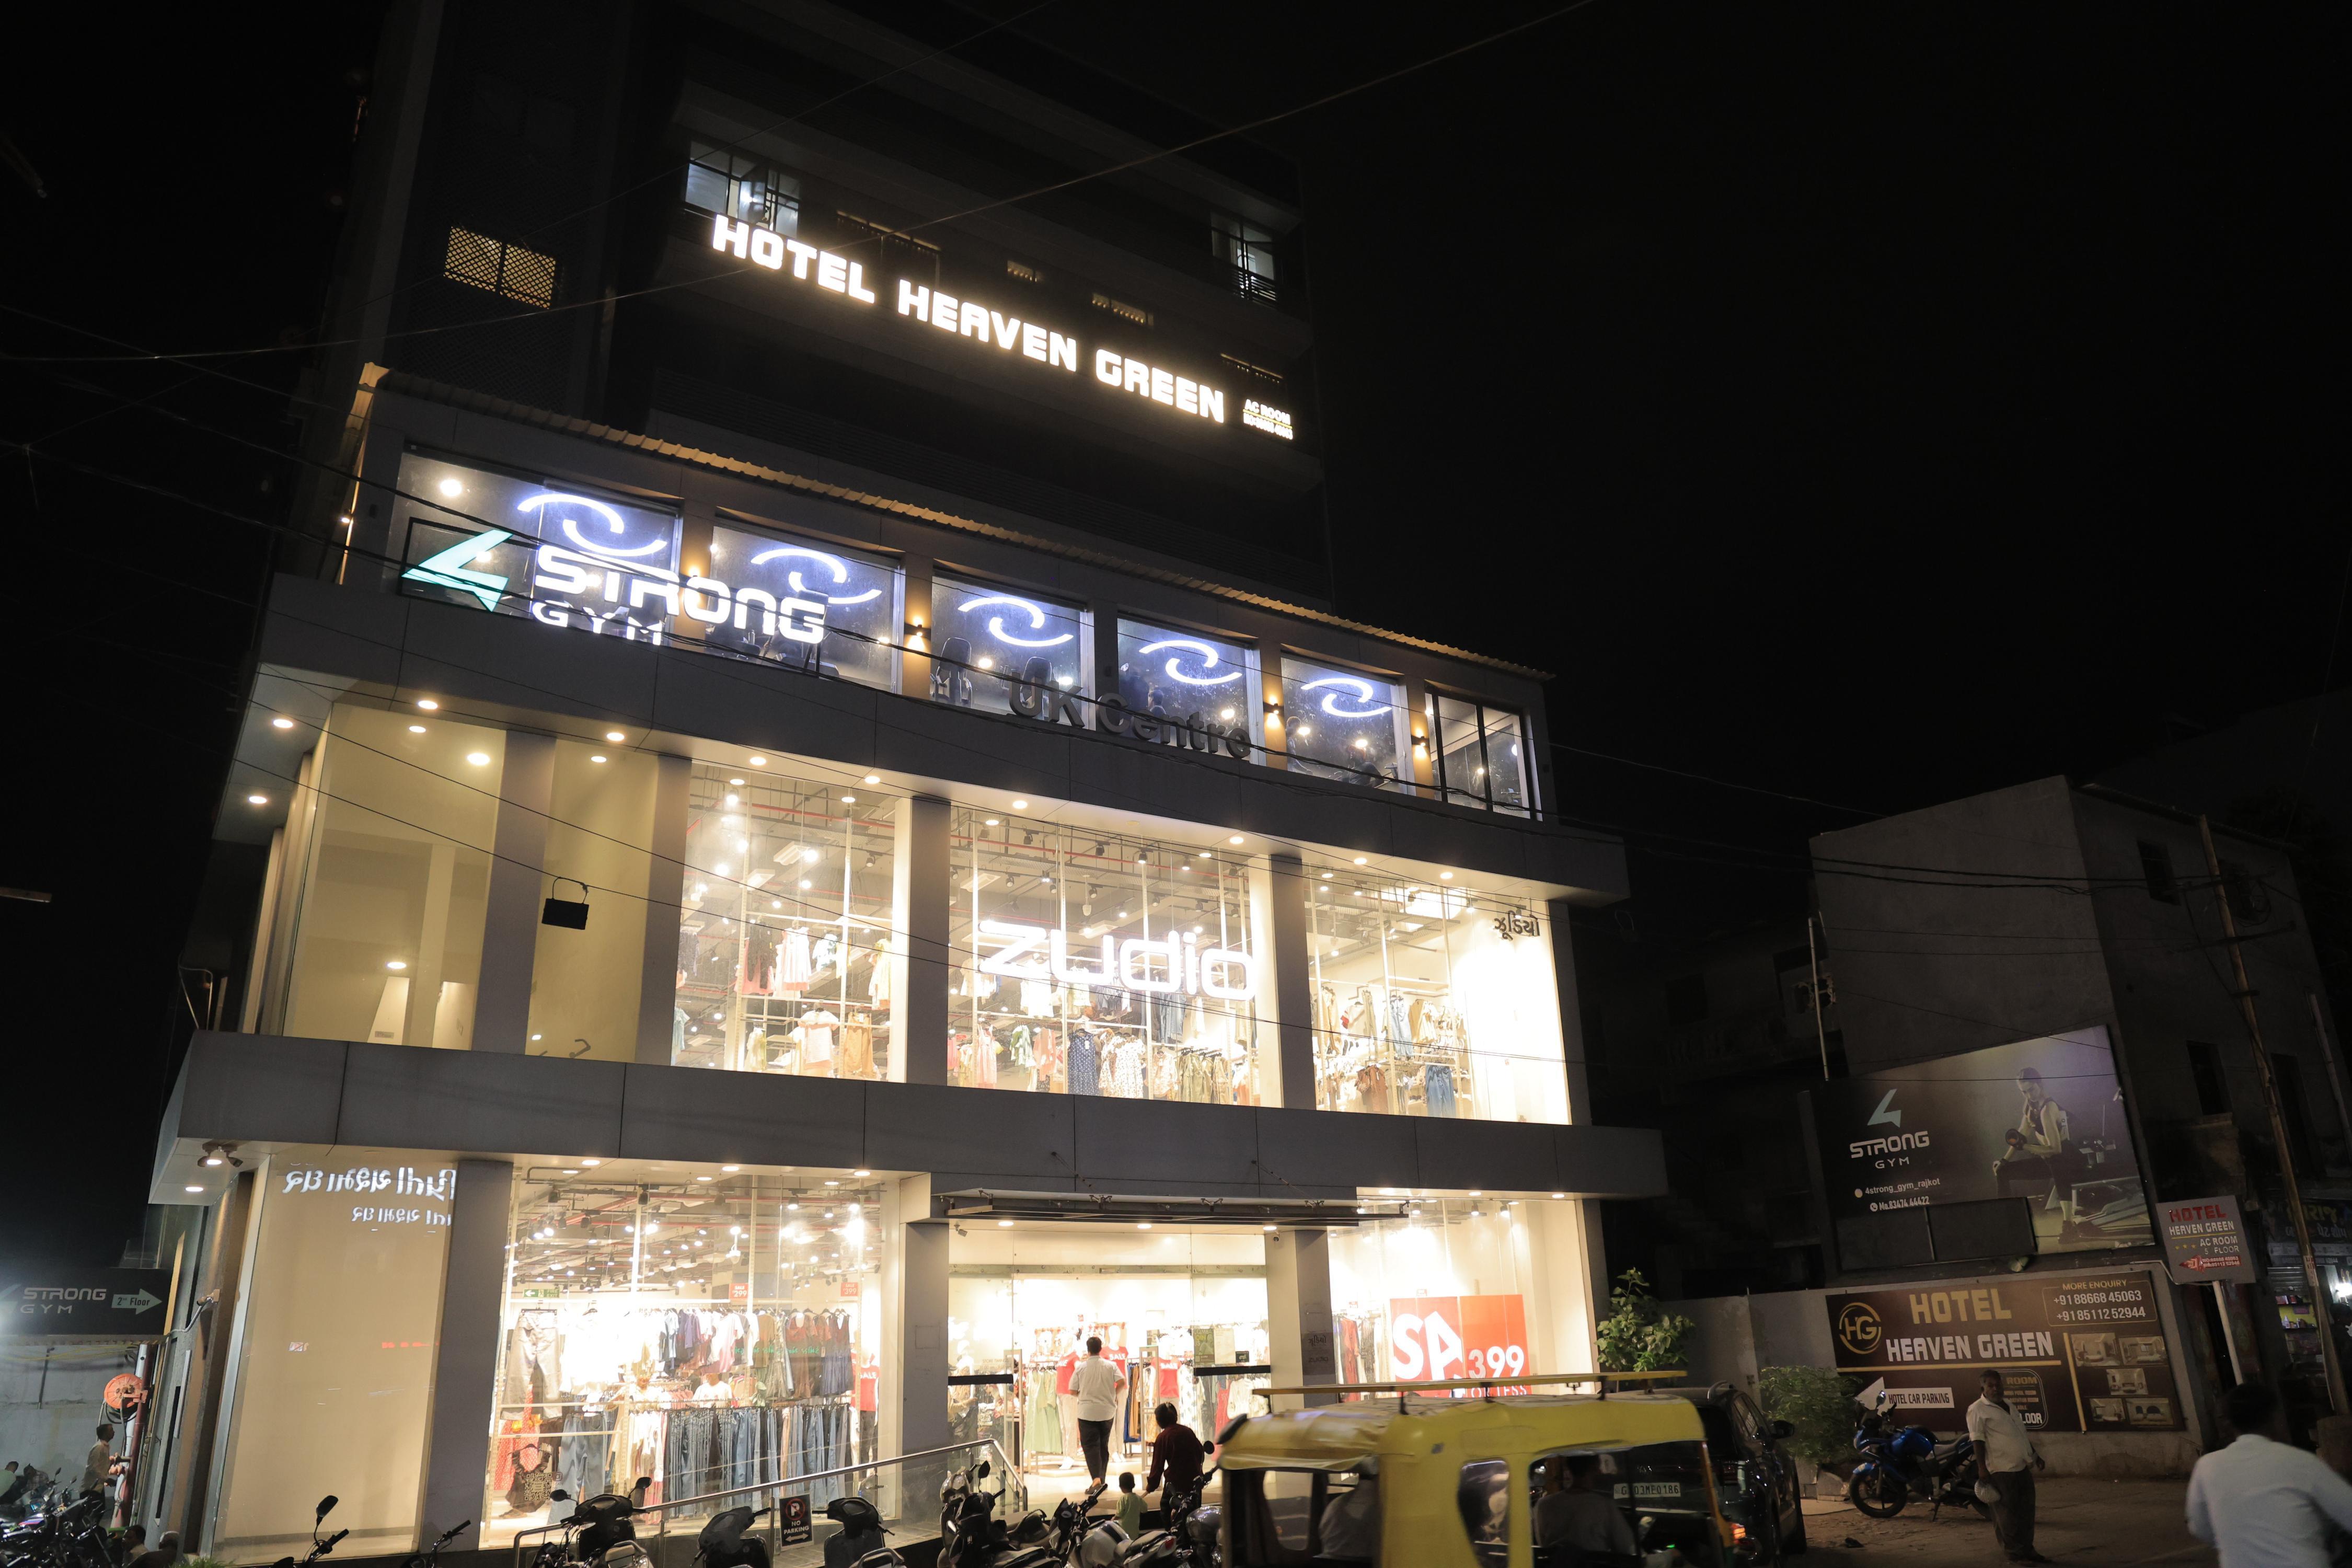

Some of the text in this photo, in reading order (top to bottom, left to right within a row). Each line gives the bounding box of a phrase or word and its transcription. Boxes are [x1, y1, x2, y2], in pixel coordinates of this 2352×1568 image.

[712, 214, 1224, 423] HOTEL HEAVEN GREEN
[535, 546, 829, 644] STRONG
[532, 602, 662, 645] GYM
[1008, 672, 1251, 759] UK Centre
[1850, 1131, 1930, 1159] STRONG
[1875, 1157, 1909, 1169] GYM
[1865, 1178, 1941, 1194] 4strong_gym_rajkot
[2169, 1205, 2228, 1223] HOTEL
[2169, 1221, 2234, 1236] HEAVEN GREEN
[2213, 1236, 2238, 1245] ROOM
[2062, 1279, 2127, 1290] MORE ENQUIRY
[23, 1287, 107, 1300] STRONG
[130, 1297, 151, 1306] Floor
[1909, 1288, 2012, 1324] HOTEL
[20, 1305, 73, 1314] GYM
[2112, 1306, 2146, 1318] 52944
[1886, 1331, 2054, 1362] HEAVEN GREEN
[1888, 1393, 1950, 1404] HOTEL CAR PARKING
[2020, 1413, 2043, 1424] LOOR
[1621, 1485, 1679, 1495] G03ME0186
[784, 1526, 809, 1535] PARKING
